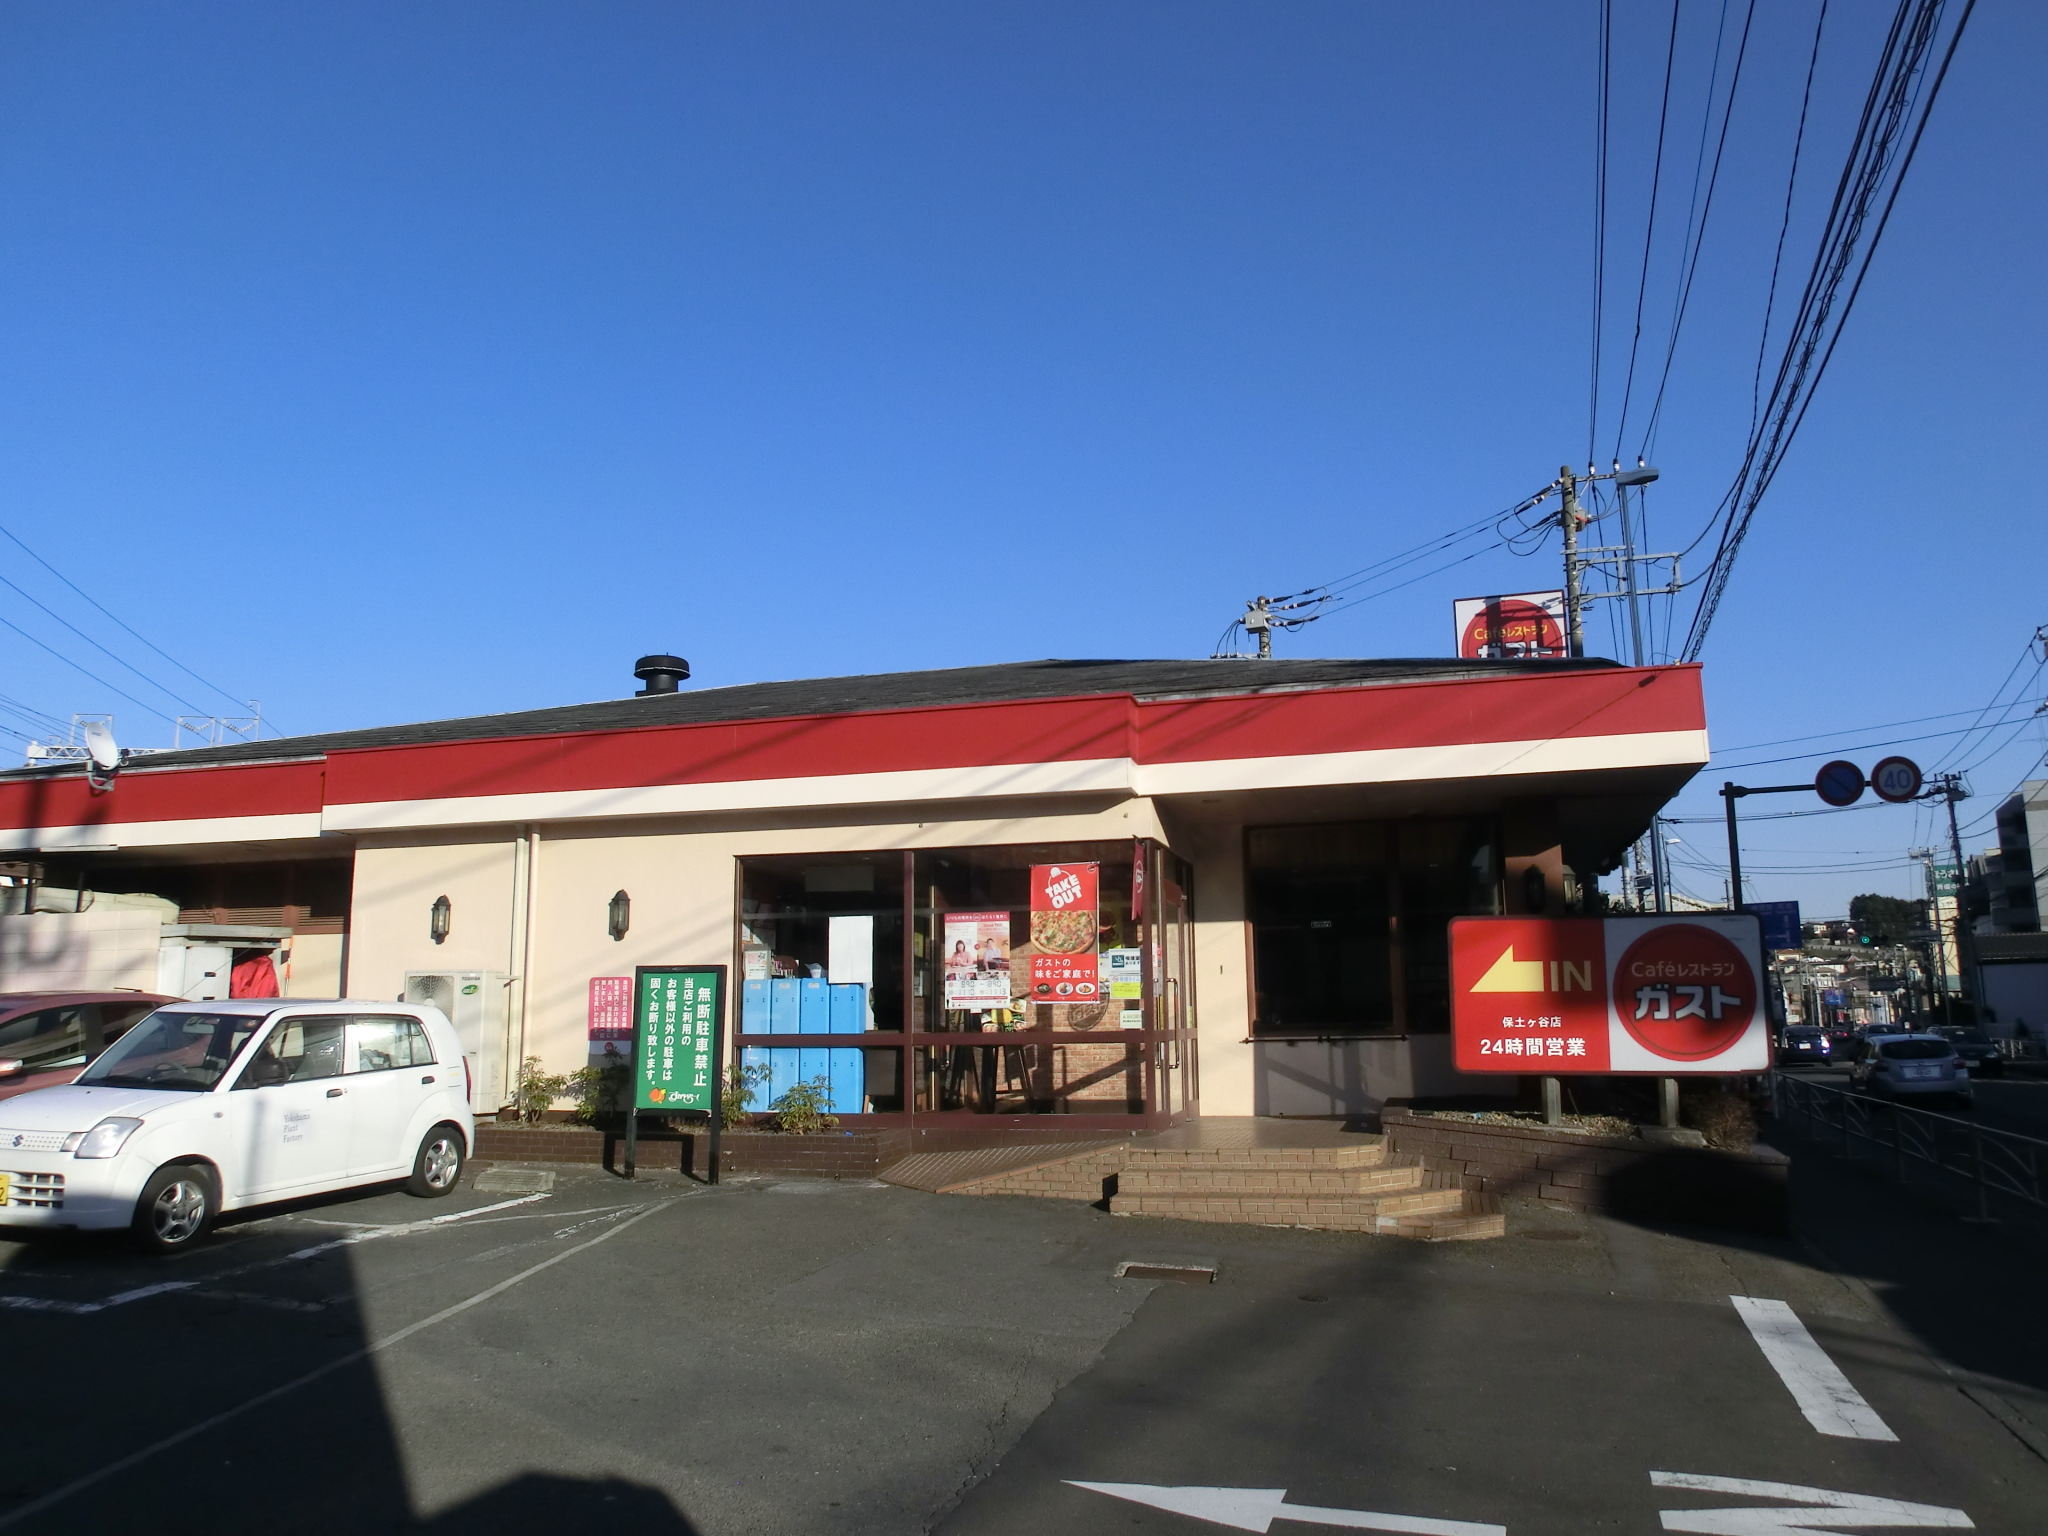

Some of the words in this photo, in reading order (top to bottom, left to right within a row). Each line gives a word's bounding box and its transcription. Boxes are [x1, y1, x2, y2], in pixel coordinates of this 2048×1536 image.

[1884, 769, 1911, 790] 40
[1045, 874, 1080, 898] TAKE
[1051, 885, 1083, 909] OUT
[1035, 958, 1071, 967] ガストの
[1550, 960, 1593, 992] IN
[681, 977, 694, 1046] 当店ご利用の
[1634, 983, 1741, 1021] ガスト
[645, 978, 661, 1085] 固くお断り致します。
[662, 978, 677, 1081] お客様以外の駐車は
[693, 987, 711, 1087] 無断駐車禁止
[1480, 1037, 1587, 1057] 24時間営業
[284, 1113, 310, 1123] Yokohama
[283, 1135, 303, 1143] Factory
